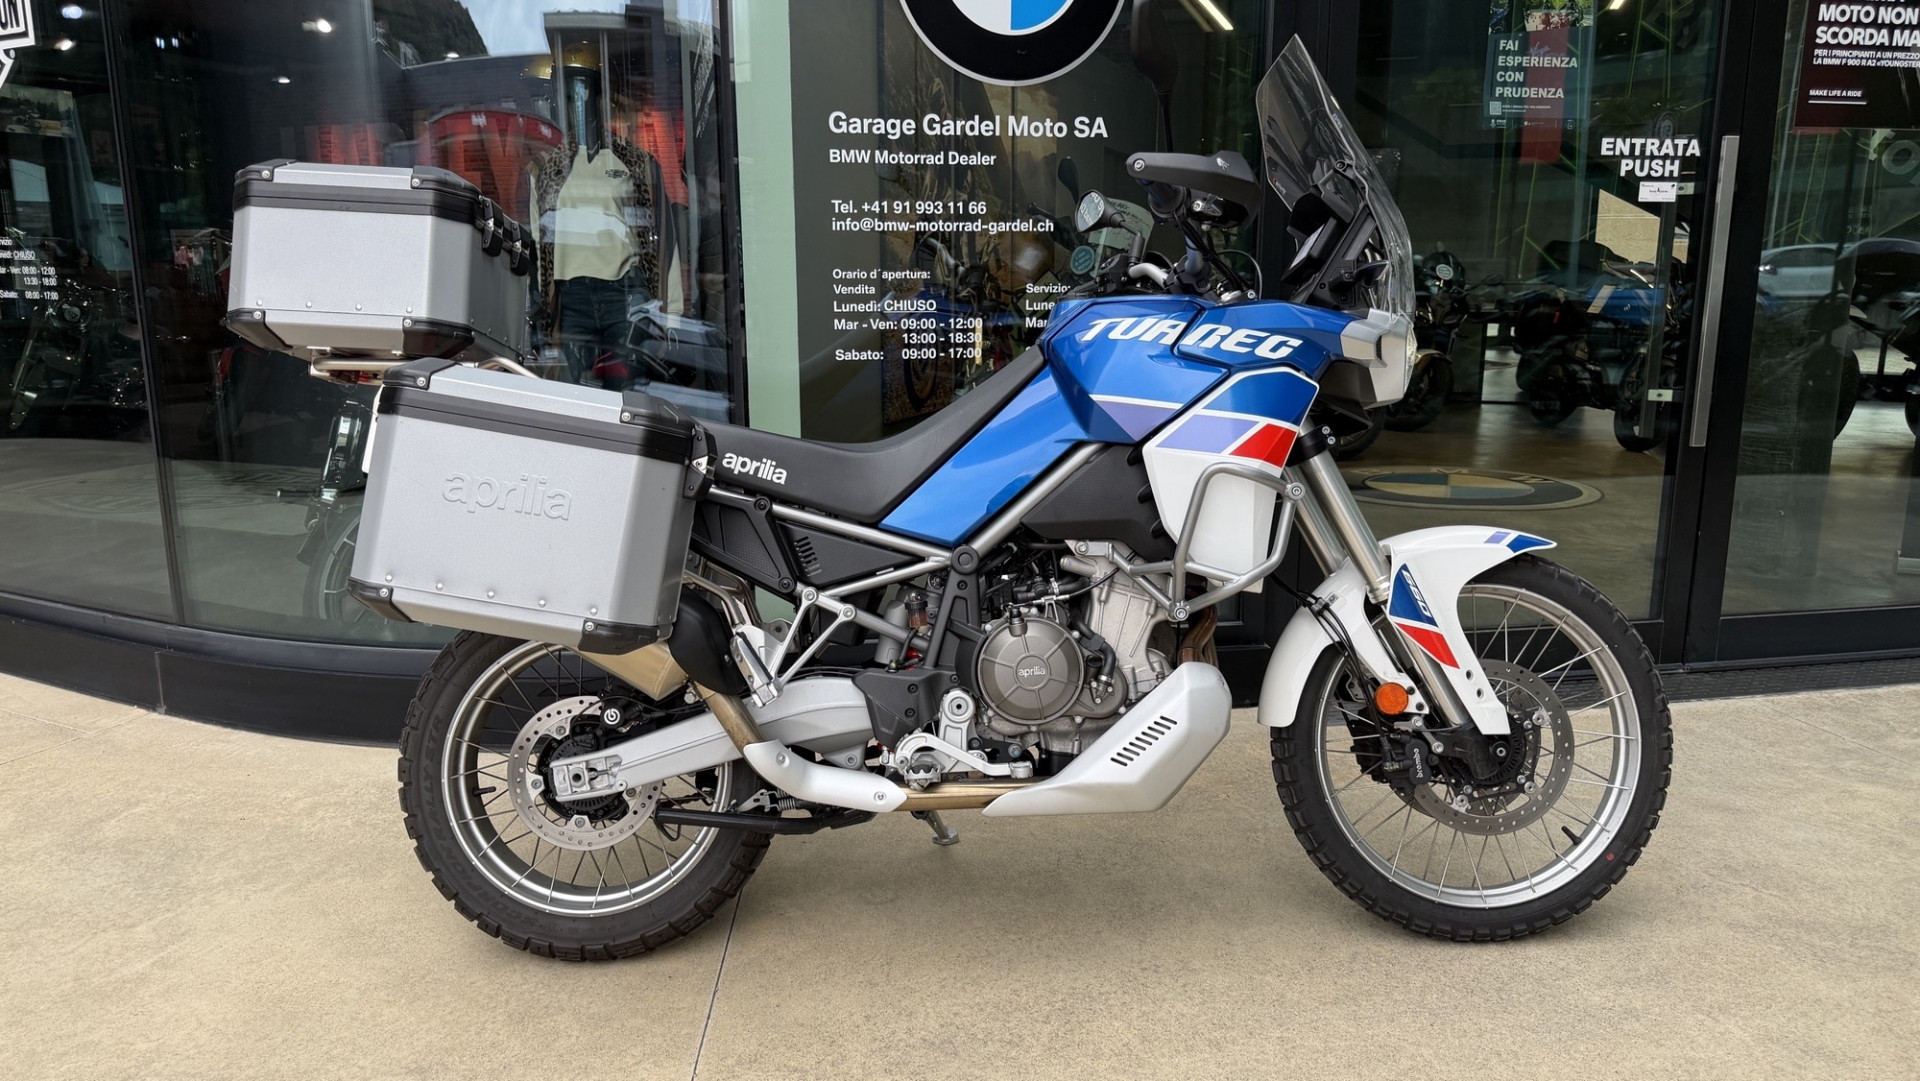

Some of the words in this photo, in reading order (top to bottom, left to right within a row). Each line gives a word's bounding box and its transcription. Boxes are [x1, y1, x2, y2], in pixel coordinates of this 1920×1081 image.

[1818, 4, 1875, 23] MOTO
[1878, 6, 1919, 25] NON
[1815, 26, 1890, 46] SCORDA
[1499, 39, 1518, 51] FAI
[1813, 49, 1828, 57] PER
[1832, 50, 1876, 59] PRINCIPIANTI
[1893, 52, 1920, 60] PREZZO
[1497, 56, 1578, 68] ESPERIENZA
[1812, 57, 1822, 65] LA
[1847, 58, 1860, 66] 900
[1496, 71, 1524, 83] CON
[1495, 87, 1564, 99] PRUDENZA
[828, 111, 916, 140] Garage
[922, 113, 1001, 137] Gardel
[1007, 115, 1068, 138] Moto
[1073, 116, 1109, 138] SA
[1600, 138, 1701, 157] ENTRATA
[829, 149, 871, 164] BMW
[874, 150, 945, 165] Motorrad
[948, 151, 997, 166] Dealer
[1620, 159, 1680, 178] PUSH
[831, 200, 858, 214] Tel.
[861, 202, 888, 214] +41
[893, 202, 911, 214] 91
[916, 202, 943, 215] 993
[947, 202, 965, 214] 11
[968, 202, 987, 215] 66
[831, 217, 1054, 234] info@bmw-motorrad-gardel.ch
[41, 267, 56, 275] 12:00
[832, 268, 868, 279] Orario
[23, 277, 38, 285] 13:30
[42, 277, 57, 286] 18:00
[833, 284, 876, 295] Vendita
[1025, 283, 1071, 294] Servizio:
[43, 292, 59, 300] 17:00
[884, 300, 937, 313] CHIUSO
[833, 319, 858, 330] Mar
[870, 318, 898, 330] Ven:
[901, 319, 936, 330] 09:00
[949, 318, 983, 329] 12:00
[902, 333, 936, 344] 13:00
[949, 332, 982, 343] 18:30
[1081, 317, 1303, 360] TUAREG
[835, 349, 884, 361] Sabato:
[902, 348, 936, 359] 09:00
[948, 348, 982, 358] 17:00
[722, 452, 788, 485] aprilia
[442, 472, 572, 521] aprilia
[1401, 570, 1433, 618] 660
[1018, 665, 1046, 678] aprilia
[1413, 747, 1424, 778] brembo
